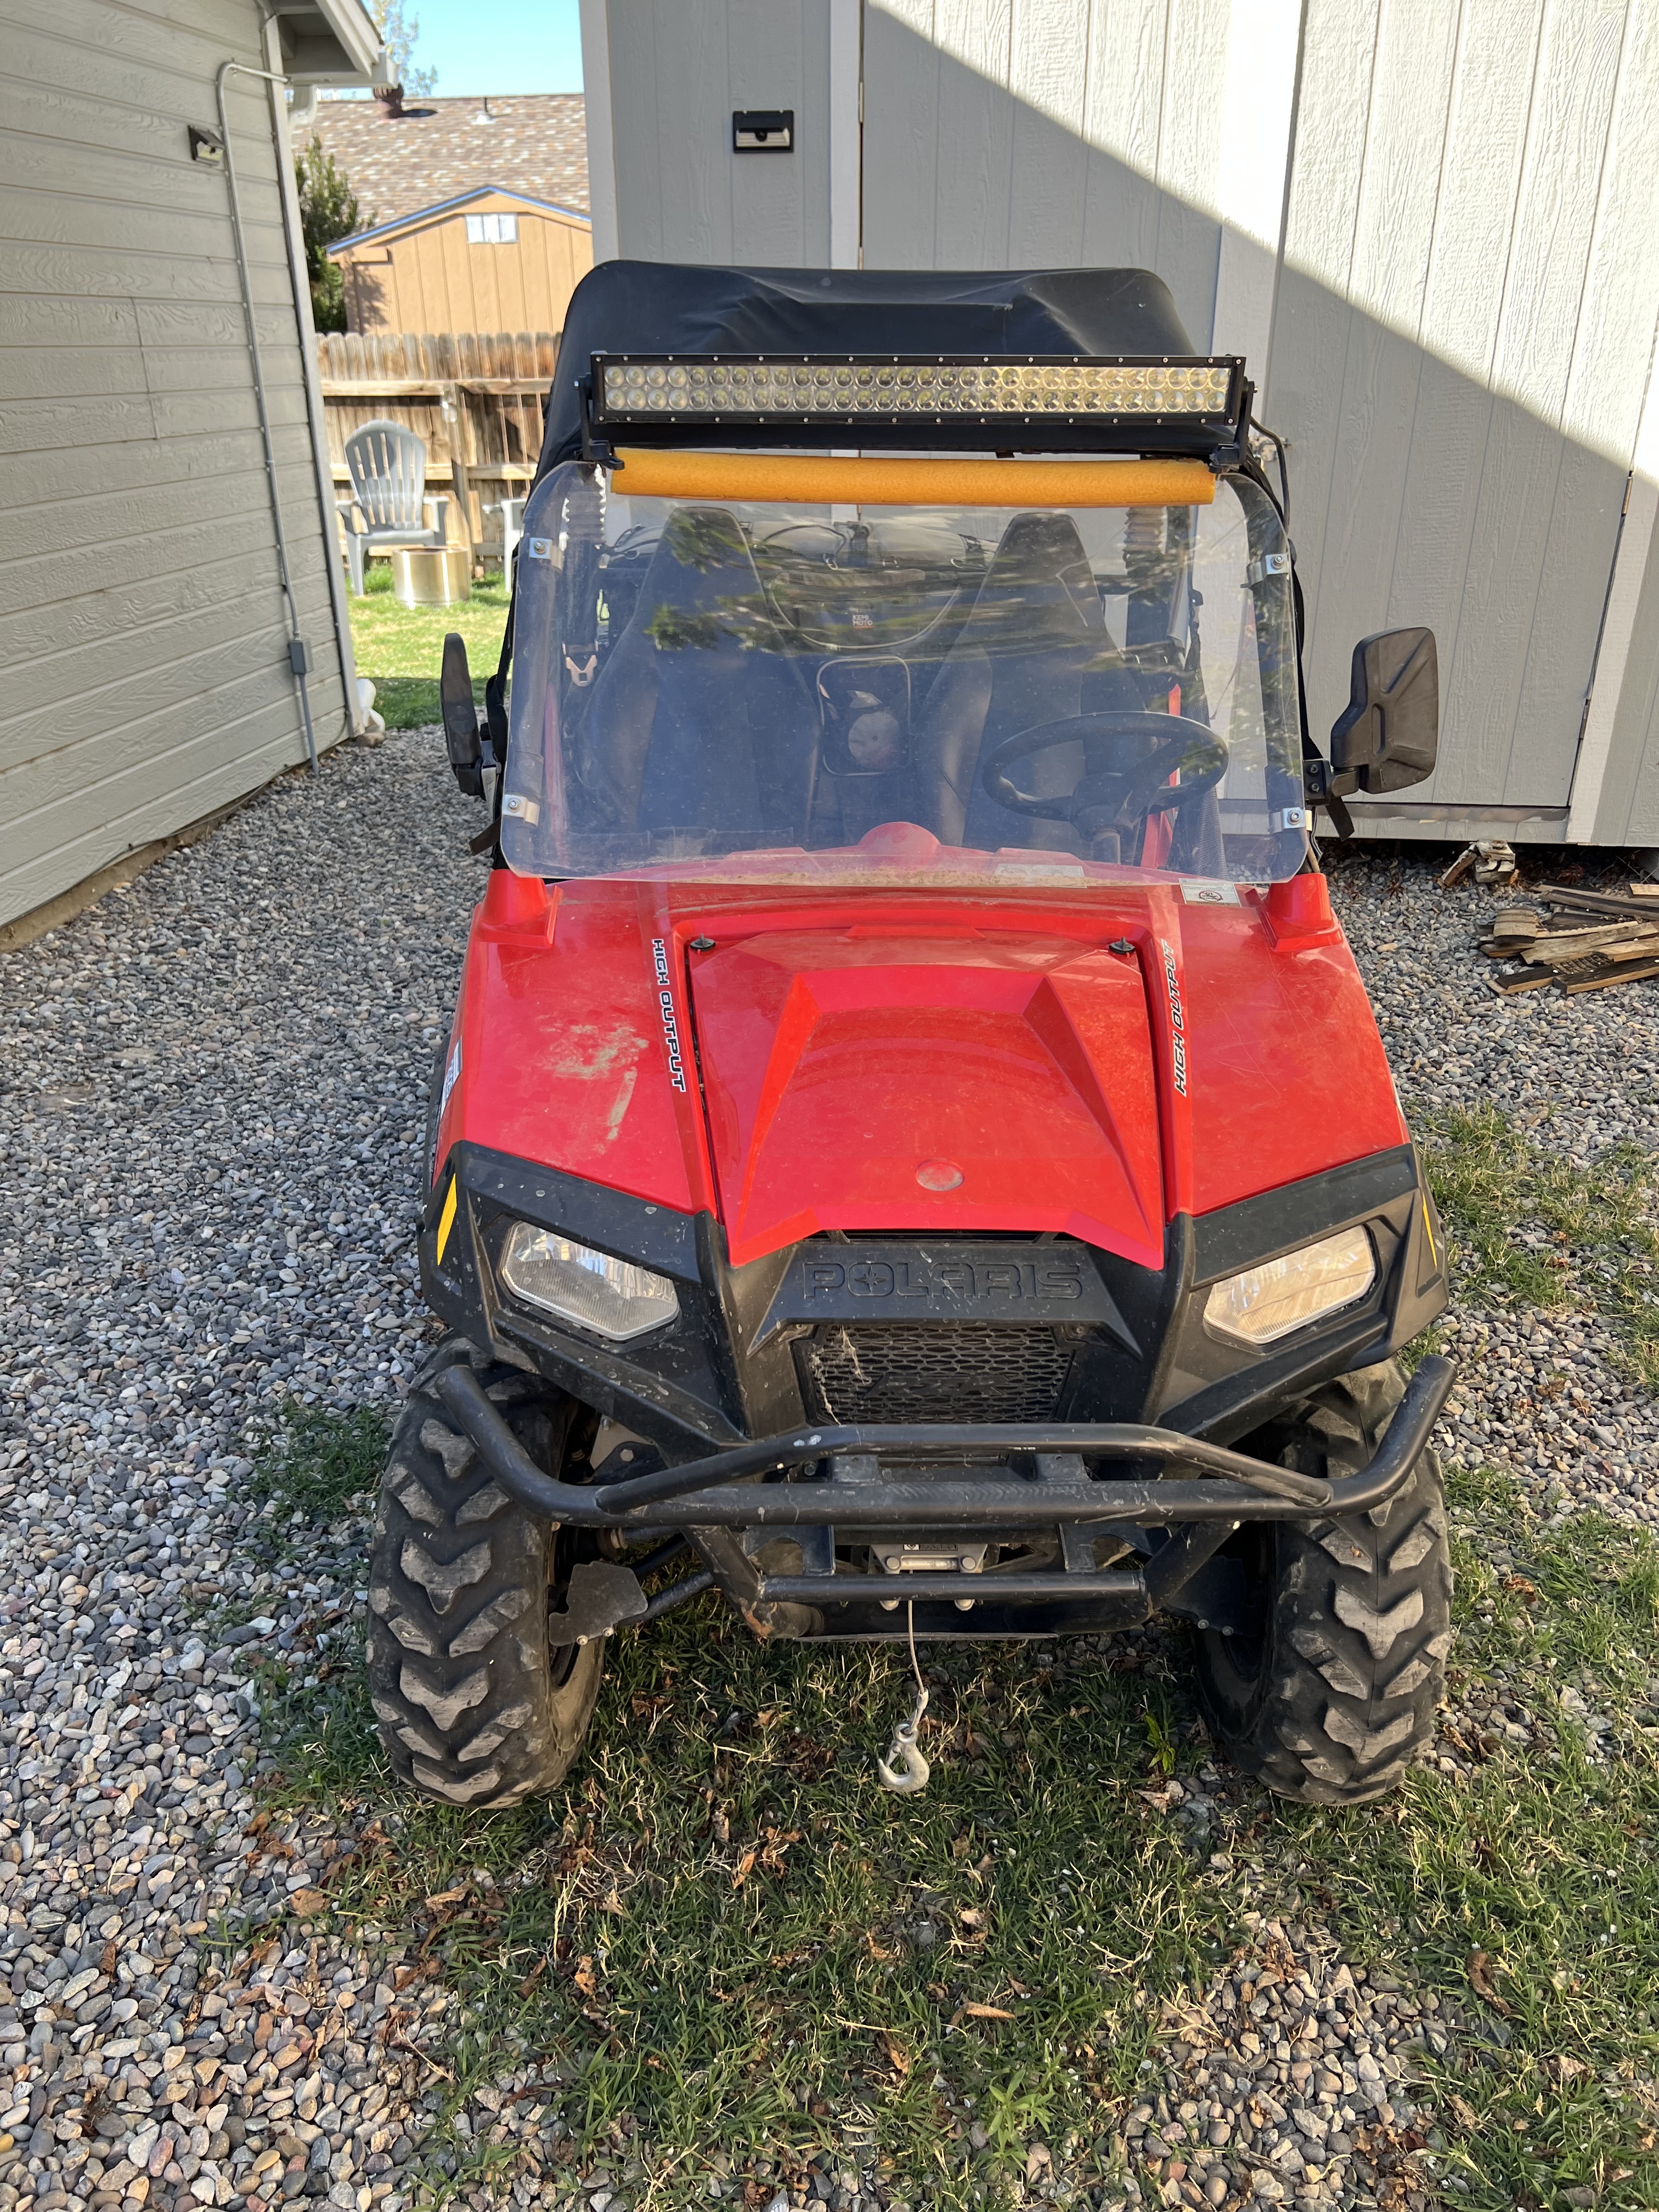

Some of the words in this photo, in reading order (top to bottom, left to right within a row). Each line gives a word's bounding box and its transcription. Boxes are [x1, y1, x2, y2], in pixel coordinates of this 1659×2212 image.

[652, 939, 670, 985] HIGH
[1161, 938, 1183, 1030] OUTPUT
[660, 991, 686, 1092] OUTPUT
[1173, 1030, 1186, 1097] HIGH
[803, 1261, 1083, 1299] POLARIS
